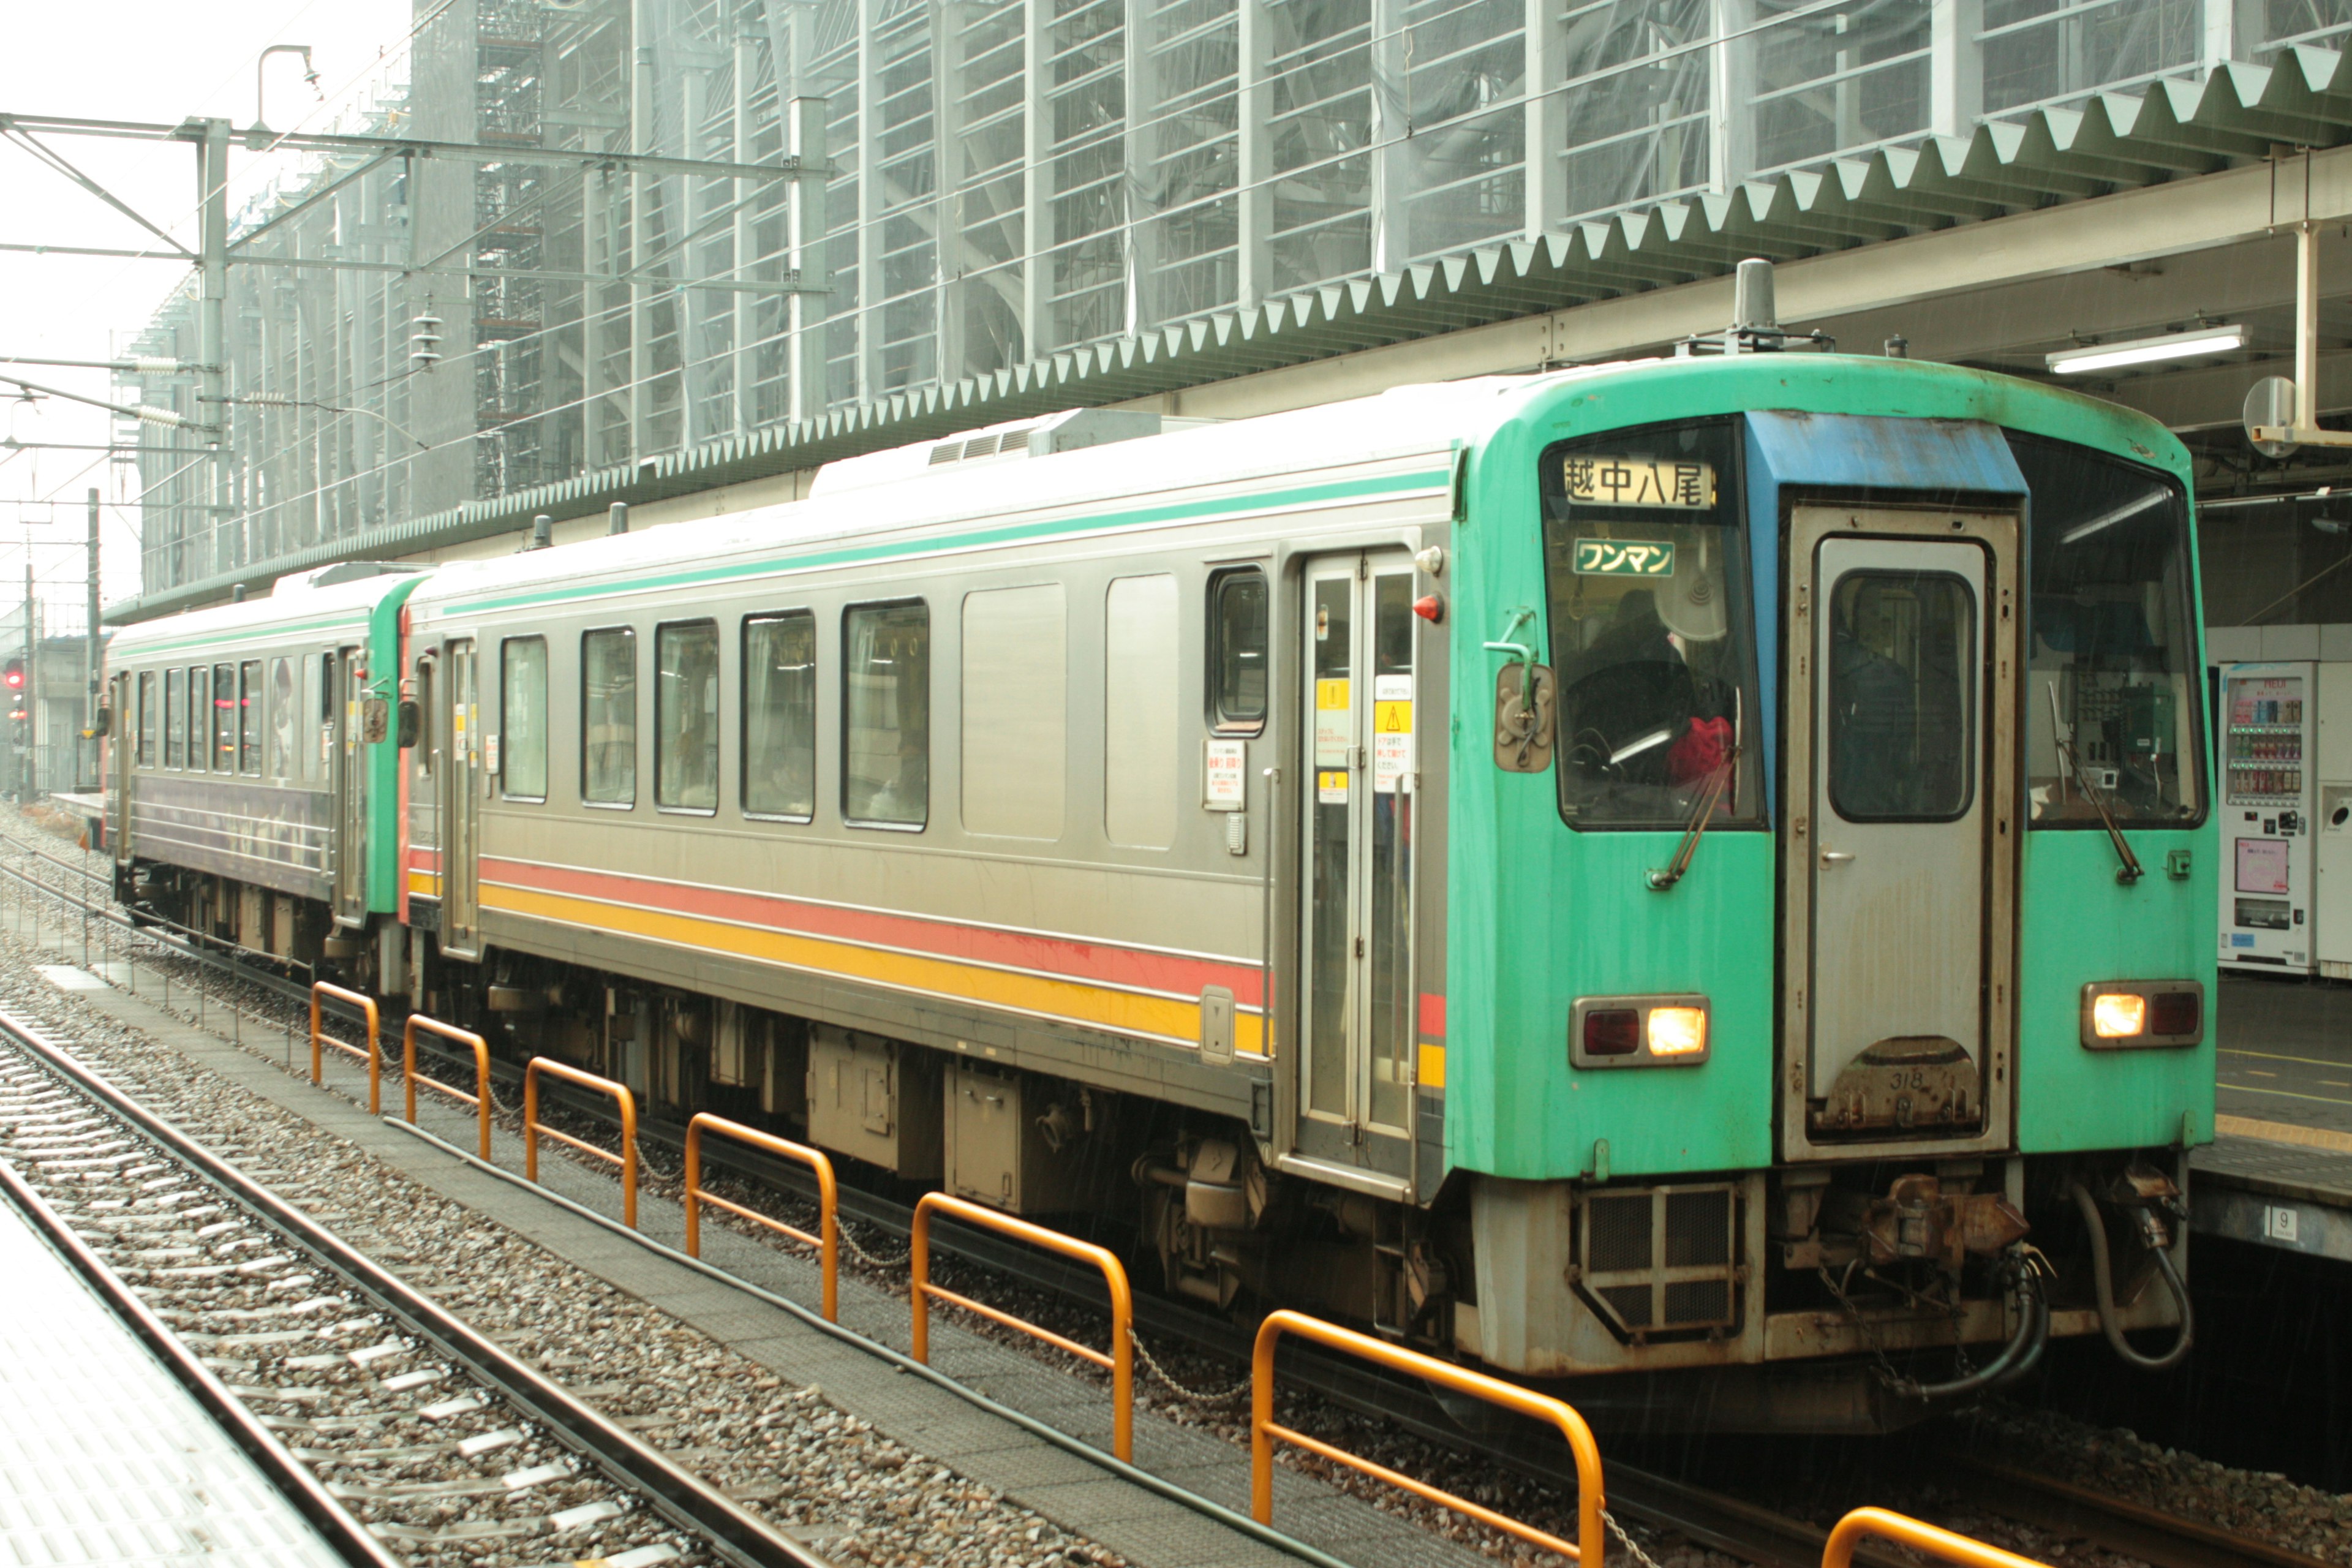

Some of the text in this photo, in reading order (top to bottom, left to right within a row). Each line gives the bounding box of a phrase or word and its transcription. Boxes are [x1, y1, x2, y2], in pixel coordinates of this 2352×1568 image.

[1565, 458, 1702, 506] 越中八尾
[1578, 543, 1672, 573] ワンマン
[1890, 1072, 1923, 1090] 318
[2280, 1211, 2288, 1229] 9
